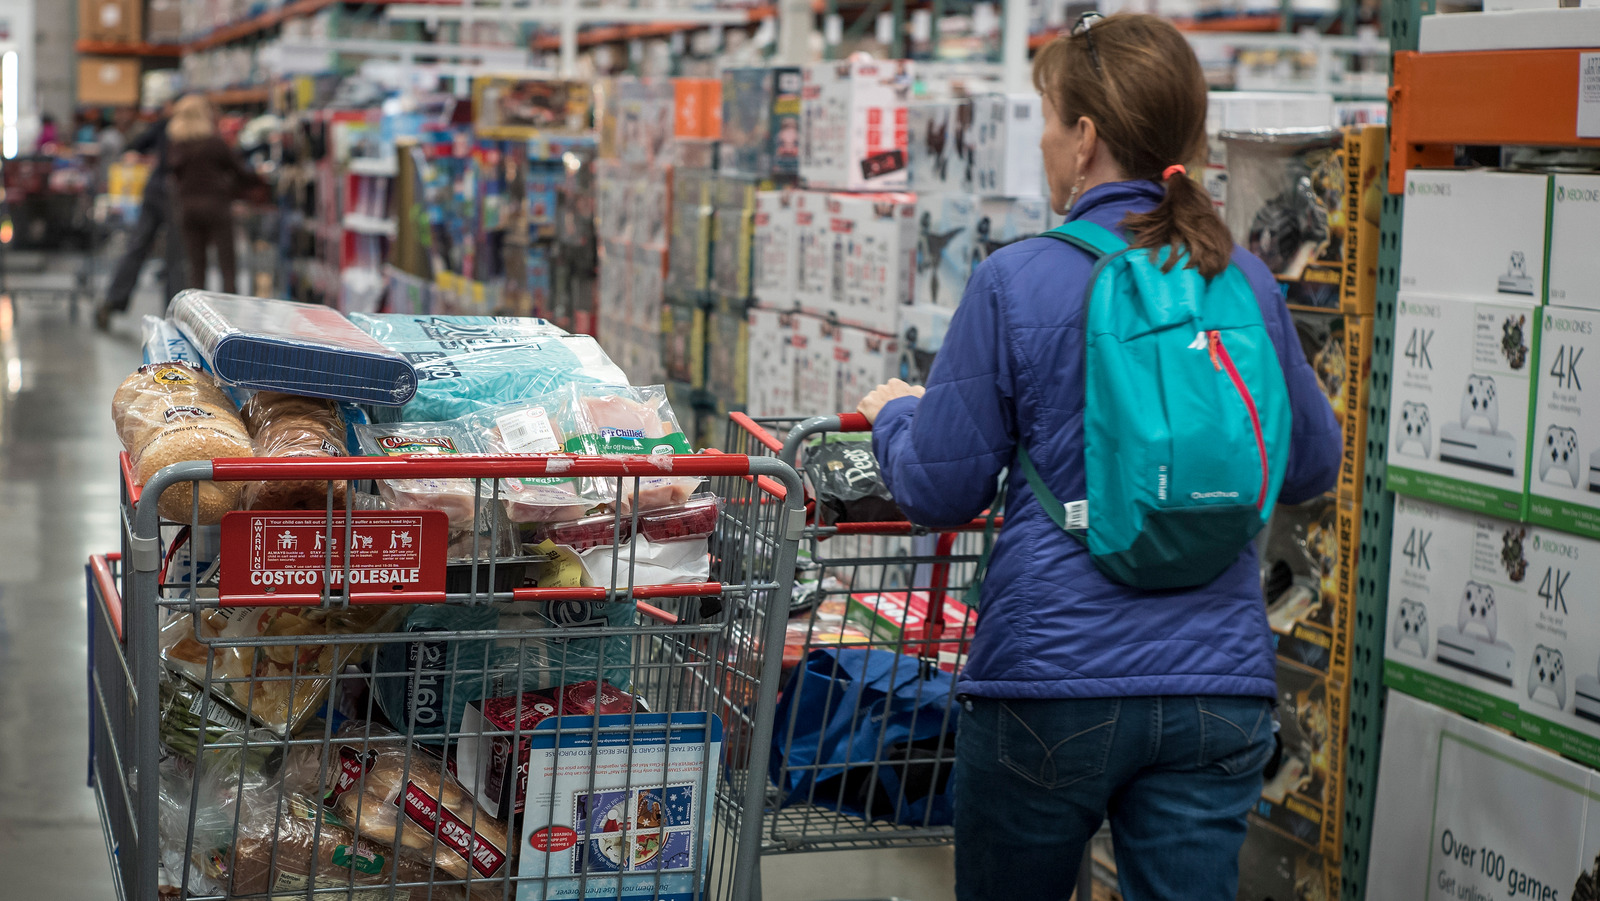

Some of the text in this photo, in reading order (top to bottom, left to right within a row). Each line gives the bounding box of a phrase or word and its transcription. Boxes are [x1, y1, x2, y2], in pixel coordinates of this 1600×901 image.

[1345, 140, 1361, 298] TRANSFORMERS
[1405, 327, 1435, 370] 4K
[1550, 343, 1584, 391] 4K
[1342, 331, 1360, 485] TRANSFORMERS
[164, 427, 186, 436] Bagels
[615, 429, 644, 438] Chilled
[254, 526, 262, 569] WARNING
[1403, 526, 1433, 571] 4K
[251, 569, 419, 585] COSTCO WHOLESALE
[1335, 514, 1352, 667] TRANSFORMERS
[1538, 565, 1571, 615] 4K
[414, 675, 438, 724] 160
[1324, 694, 1341, 845] TRANSFORMERS
[441, 820, 498, 869] SESAME
[1441, 829, 1558, 901] Over 100 games
[281, 873, 300, 881] Nutrition
[603, 886, 616, 894] Use
[1438, 869, 1456, 897] Get
